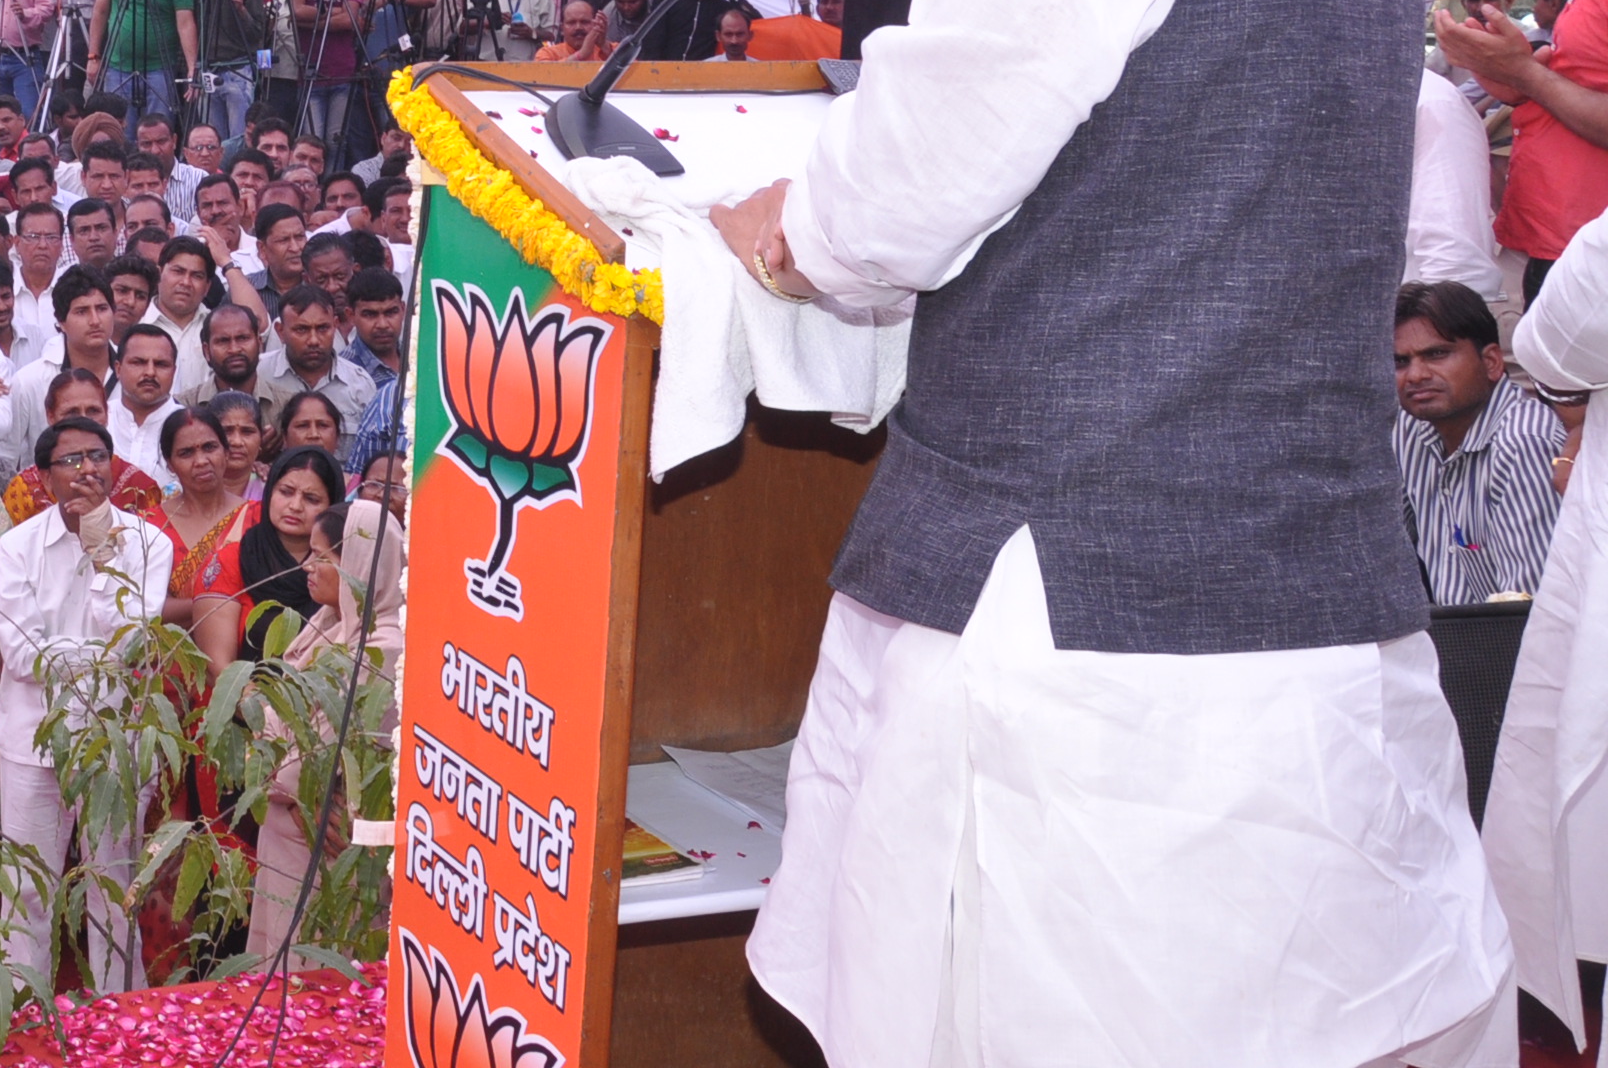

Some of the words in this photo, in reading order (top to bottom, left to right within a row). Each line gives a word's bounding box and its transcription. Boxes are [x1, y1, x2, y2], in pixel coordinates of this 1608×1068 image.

[441, 641, 555, 770] भारतीय
[412, 724, 502, 843] जनता
[507, 796, 578, 898] पार्टी
[405, 801, 488, 942] दिल्ली
[492, 893, 571, 1013] प्रदेश
